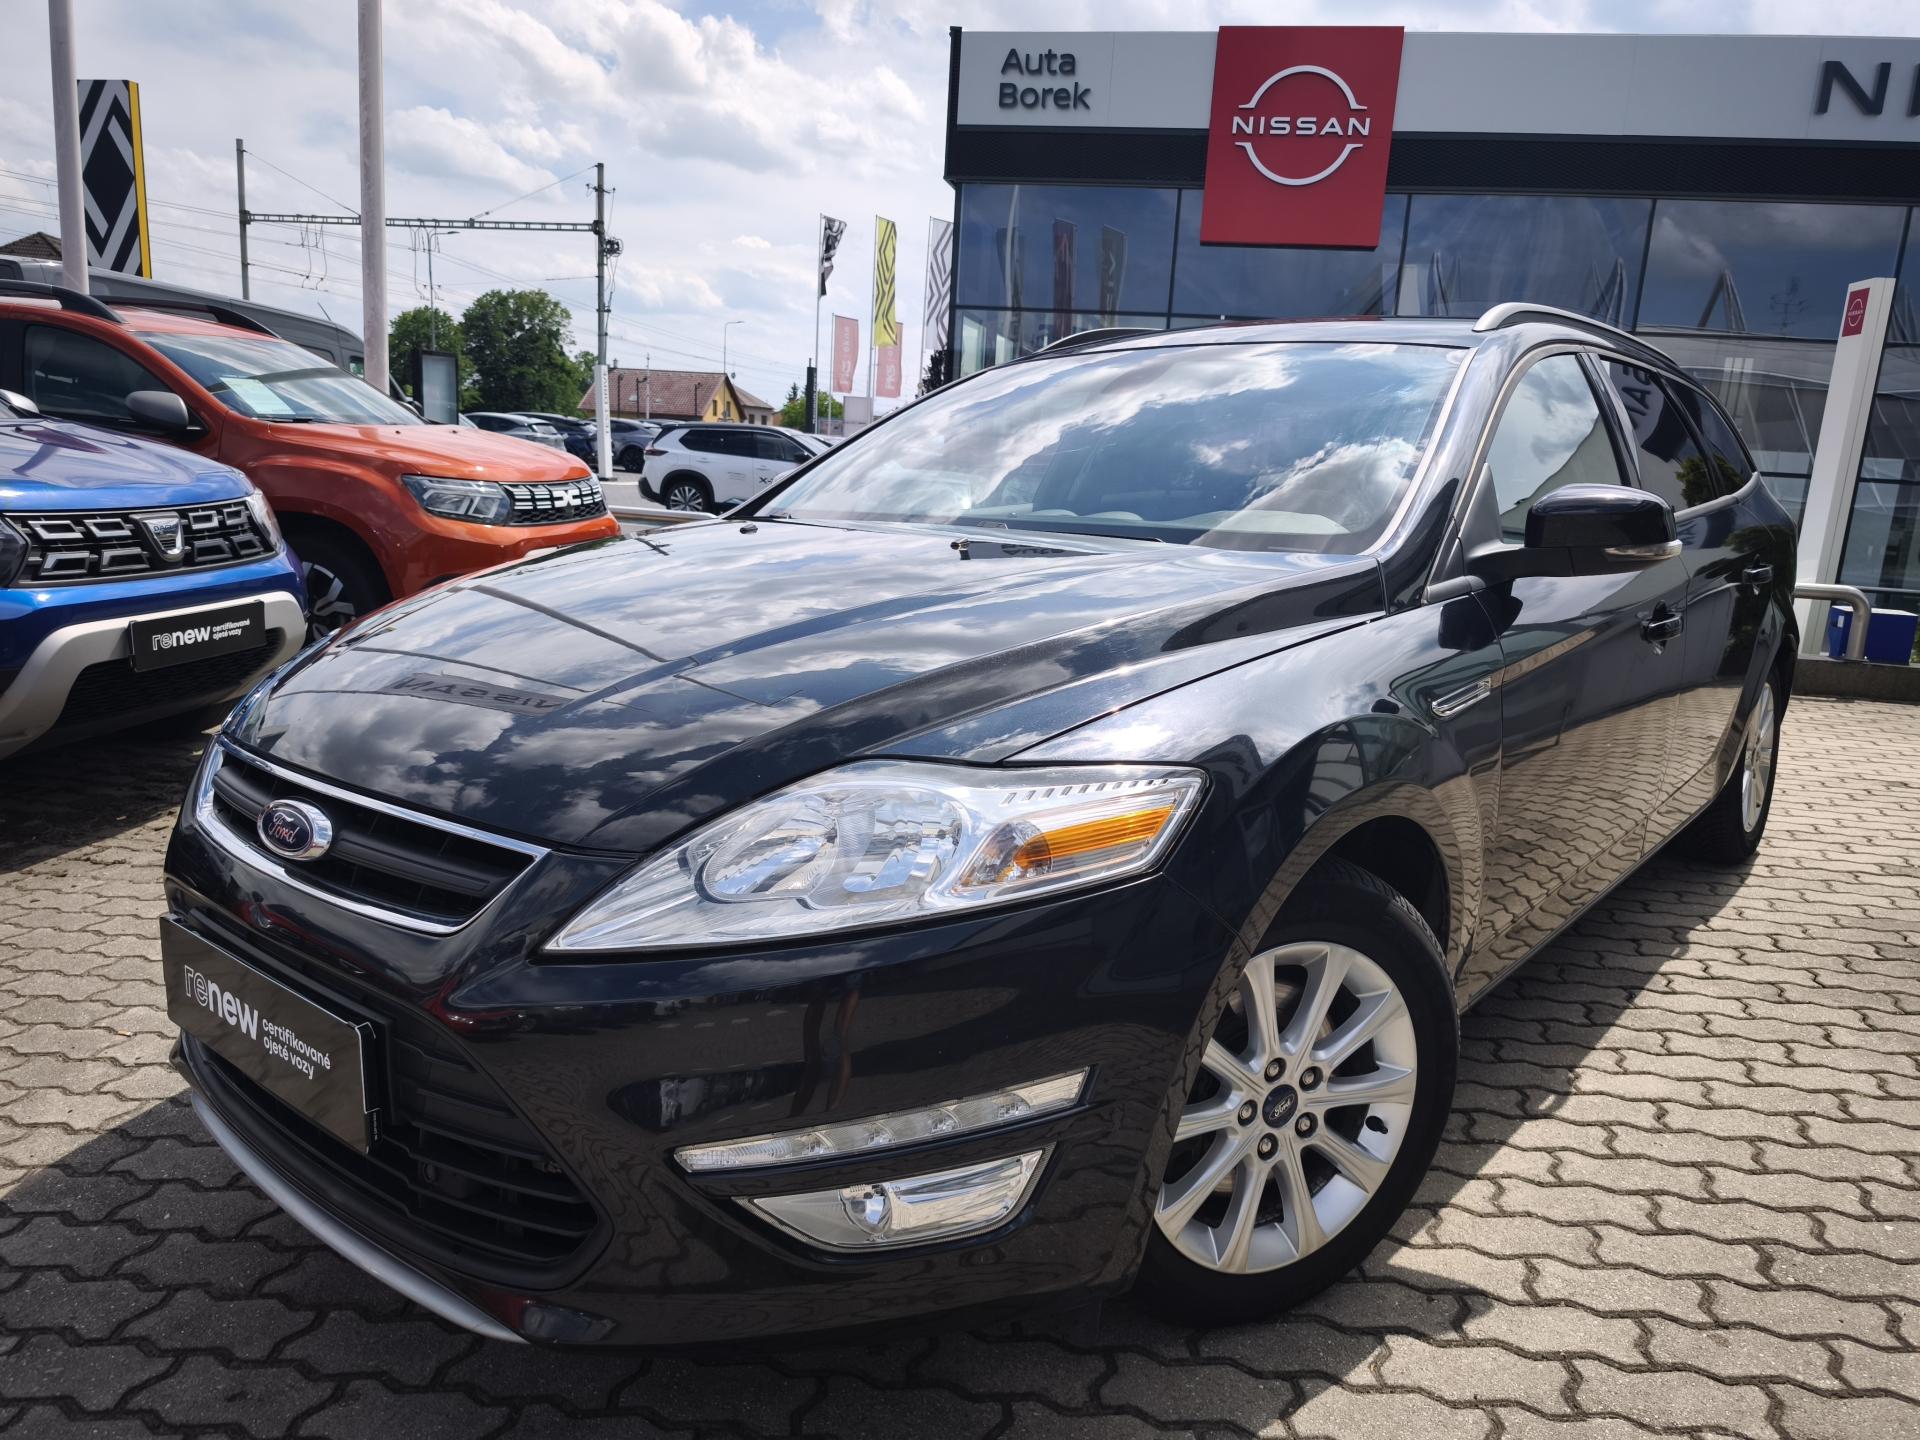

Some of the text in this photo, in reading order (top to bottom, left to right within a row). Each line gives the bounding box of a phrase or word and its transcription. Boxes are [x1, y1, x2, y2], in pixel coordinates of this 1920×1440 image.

[1001, 48, 1076, 76] Auta
[999, 81, 1091, 111] Borek
[1232, 116, 1371, 136] NISSAN
[152, 626, 210, 651] renew
[268, 812, 300, 843] Ford
[184, 965, 331, 1070] renew certifikované
[263, 1036, 314, 1080] ojeté vozy
